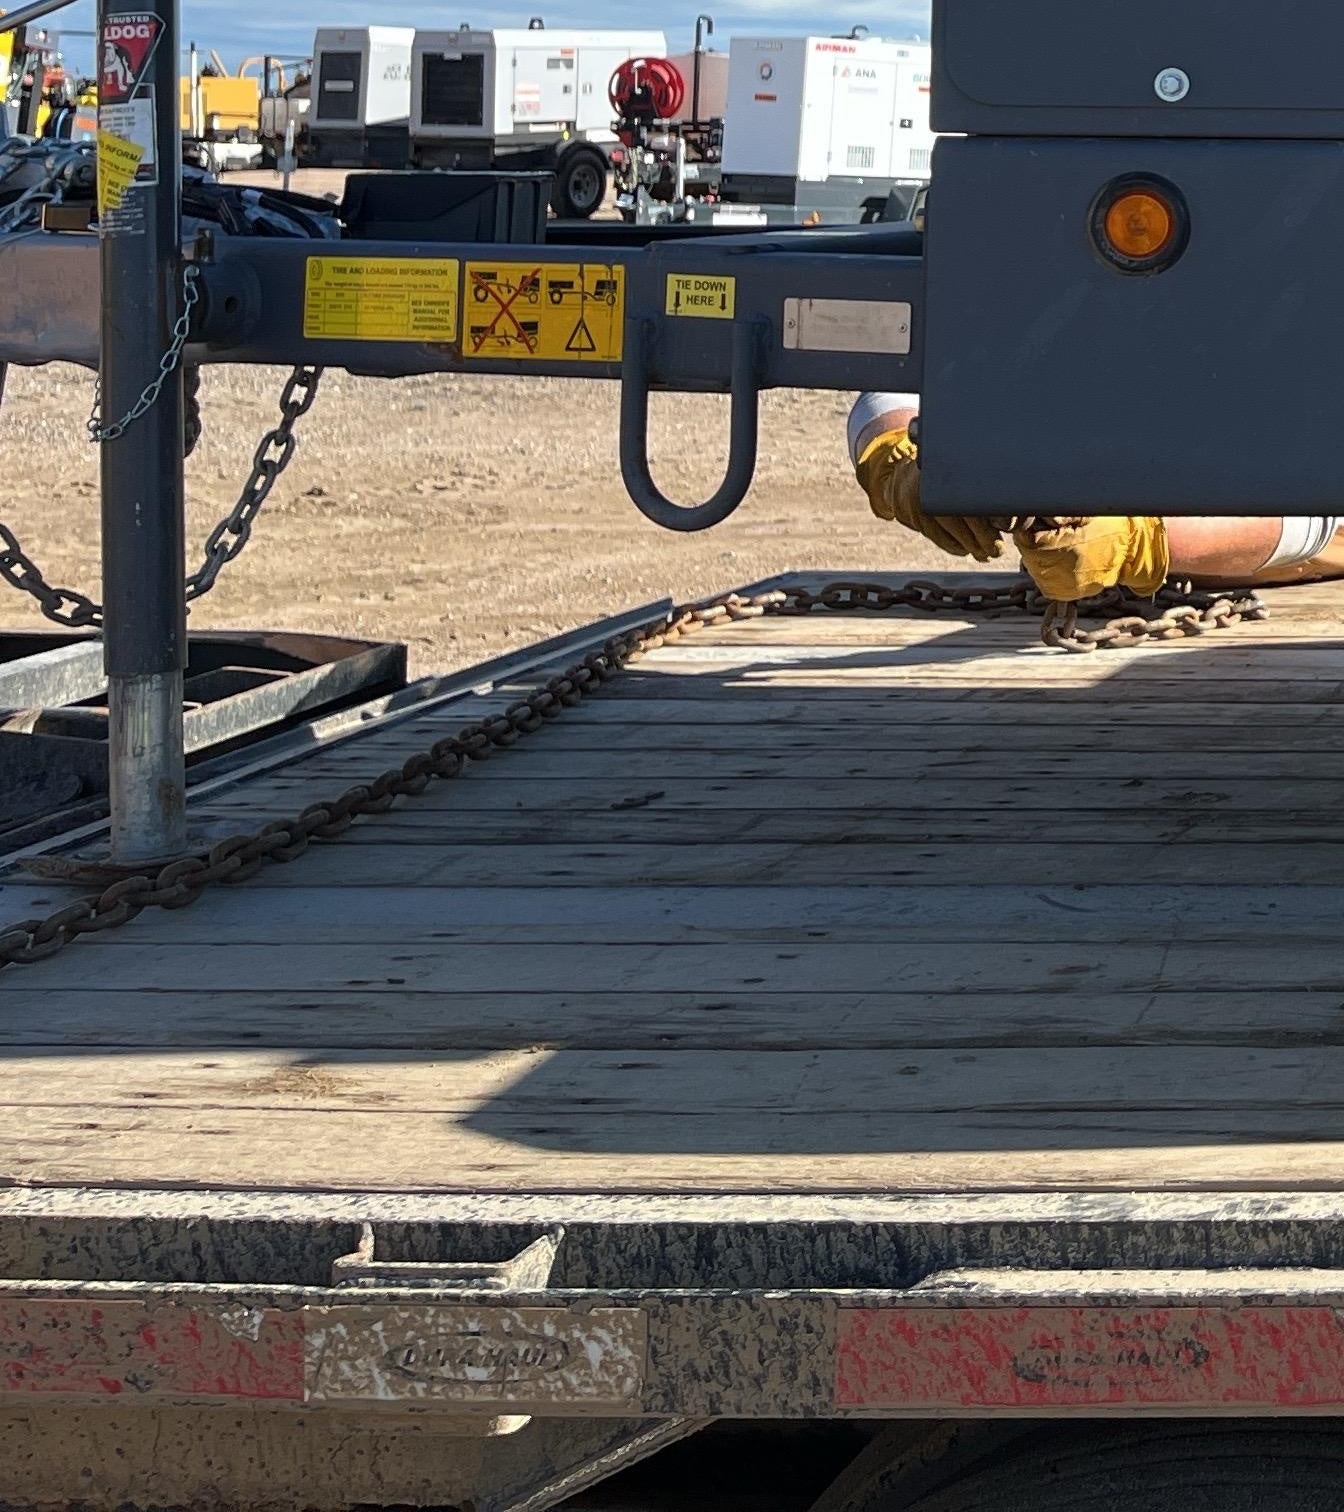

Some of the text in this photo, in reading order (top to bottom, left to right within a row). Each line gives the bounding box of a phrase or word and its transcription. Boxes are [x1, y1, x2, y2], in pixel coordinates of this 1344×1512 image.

[855, 70, 876, 78] ANA
[676, 280, 726, 292] TIE DOWN
[686, 295, 714, 305] HERE
